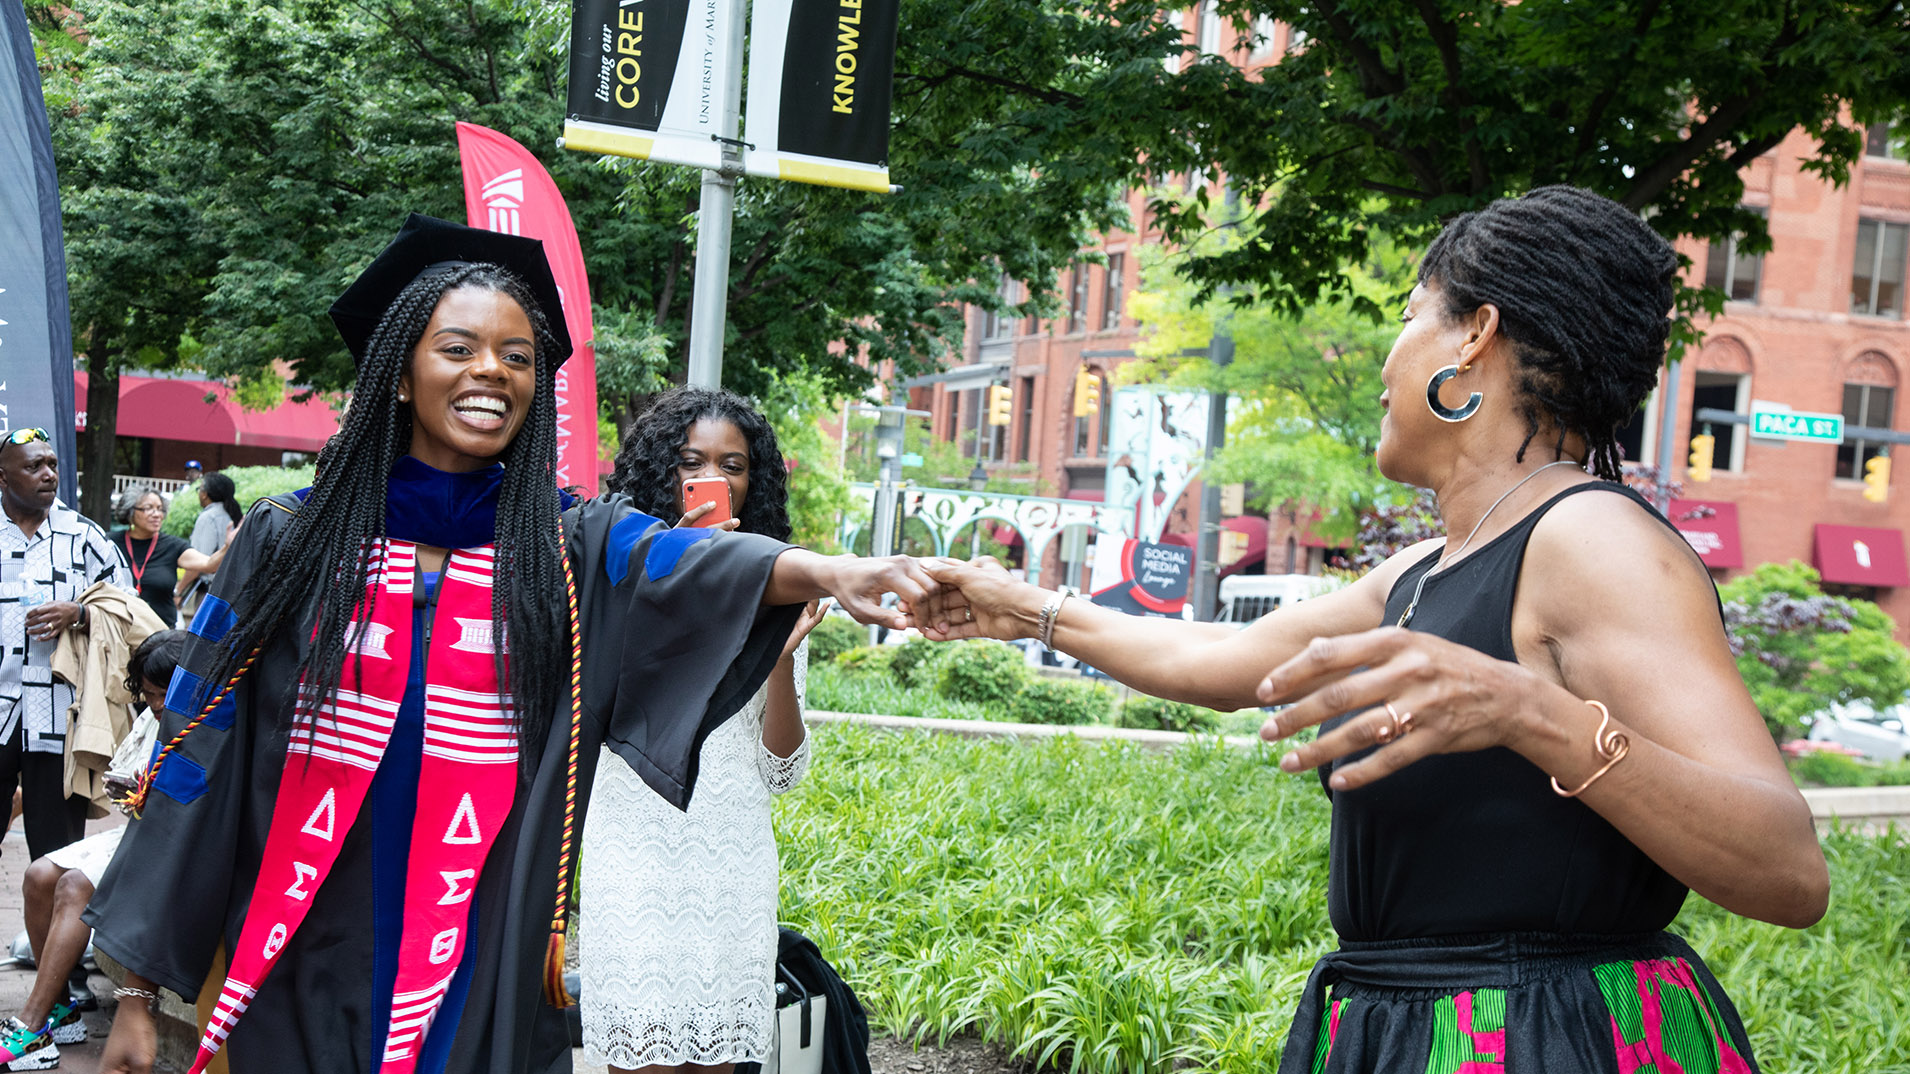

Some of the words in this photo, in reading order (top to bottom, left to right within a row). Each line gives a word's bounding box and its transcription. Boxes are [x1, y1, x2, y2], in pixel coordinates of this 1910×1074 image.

[602, 24, 612, 53] our
[615, 8, 644, 109] CORE
[595, 55, 615, 103] living
[699, 48, 712, 124] UNIVERSITY
[707, 34, 716, 46] of
[1759, 414, 1809, 434] PACA
[1141, 559, 1181, 574] MEDIA
[1142, 547, 1188, 565] SOCIAL
